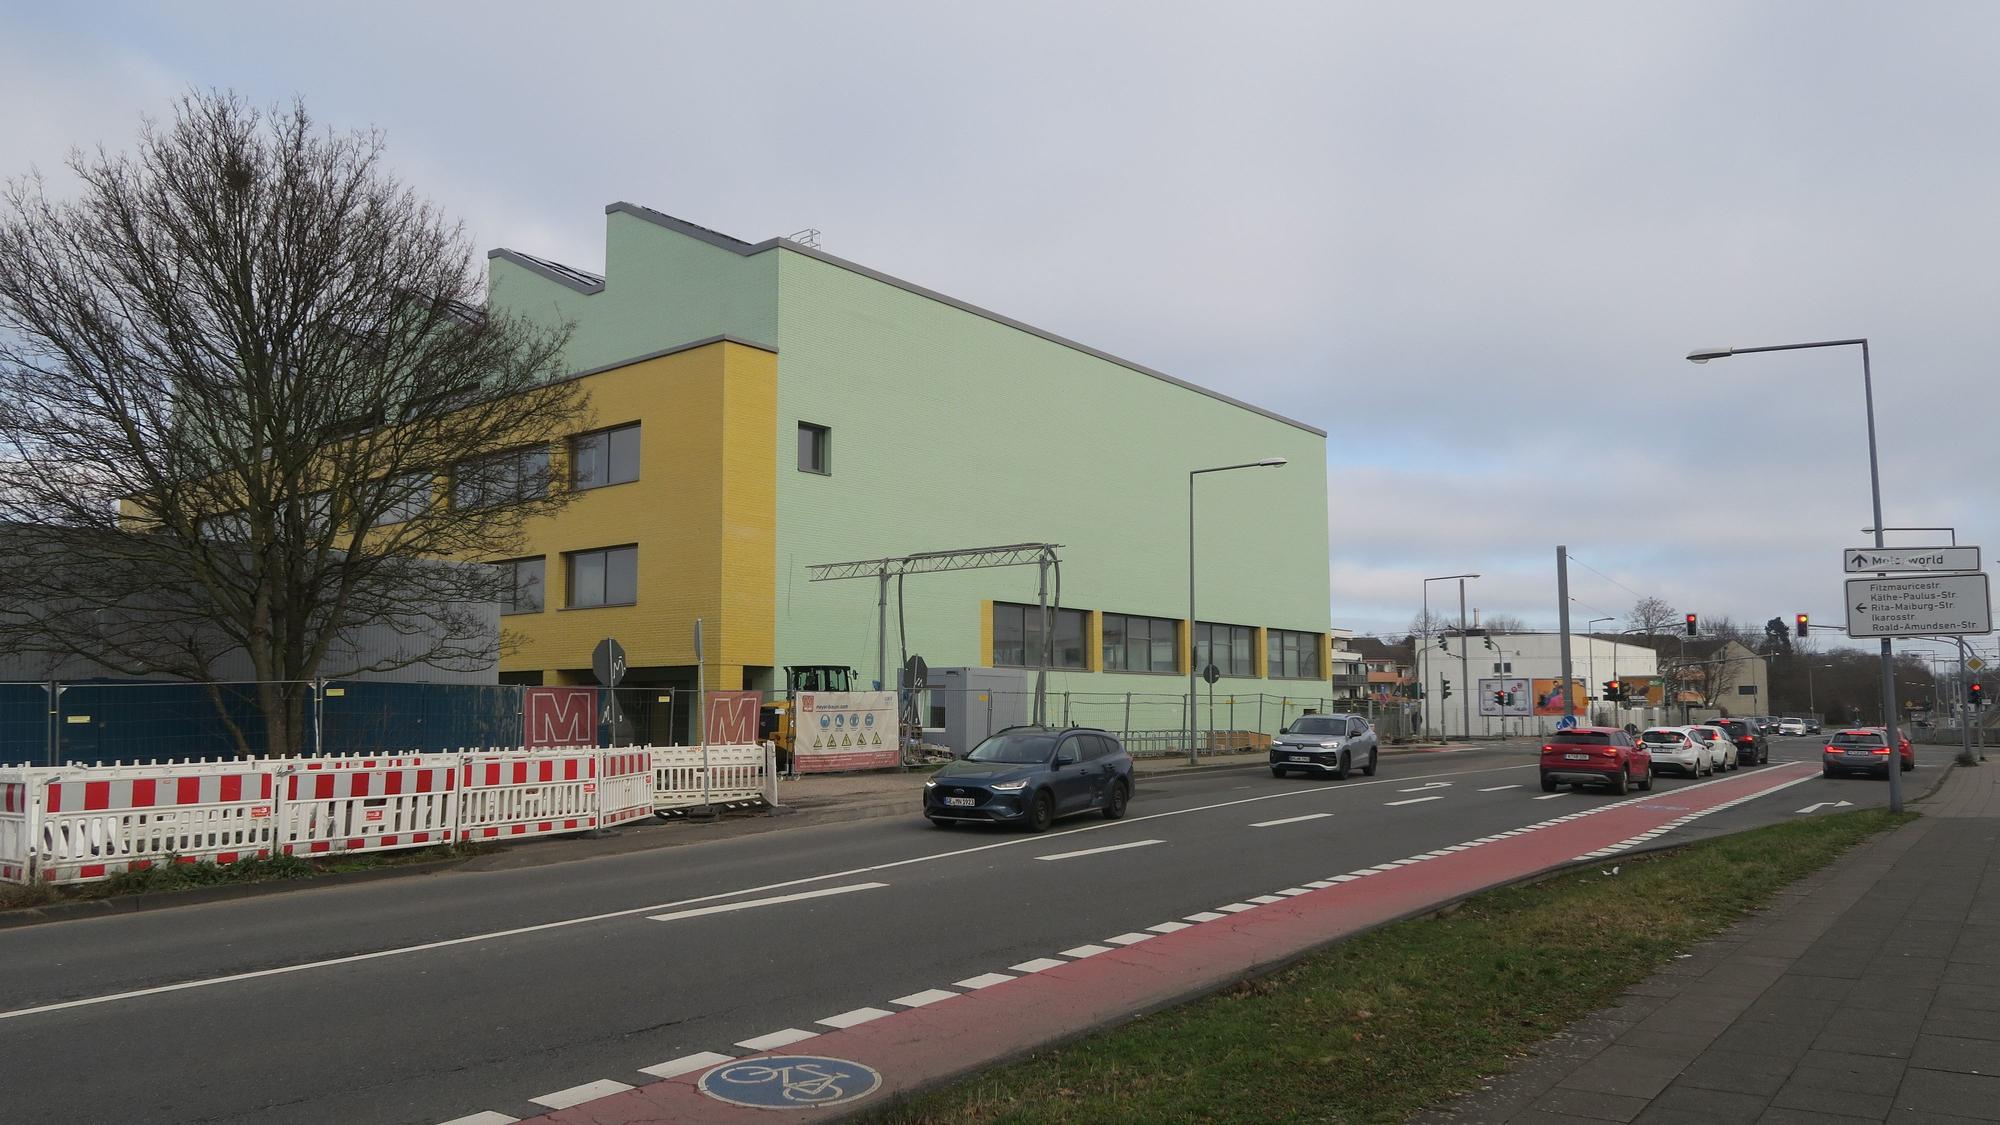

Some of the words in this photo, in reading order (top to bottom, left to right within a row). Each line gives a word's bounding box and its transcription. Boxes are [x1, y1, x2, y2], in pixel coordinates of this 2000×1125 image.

[1871, 601, 1956, 612] Rita-Maiburg-Str.
[1872, 621, 1978, 632] Roald-Amundsen-Str.
[533, 693, 591, 743] M
[709, 698, 757, 745] M
